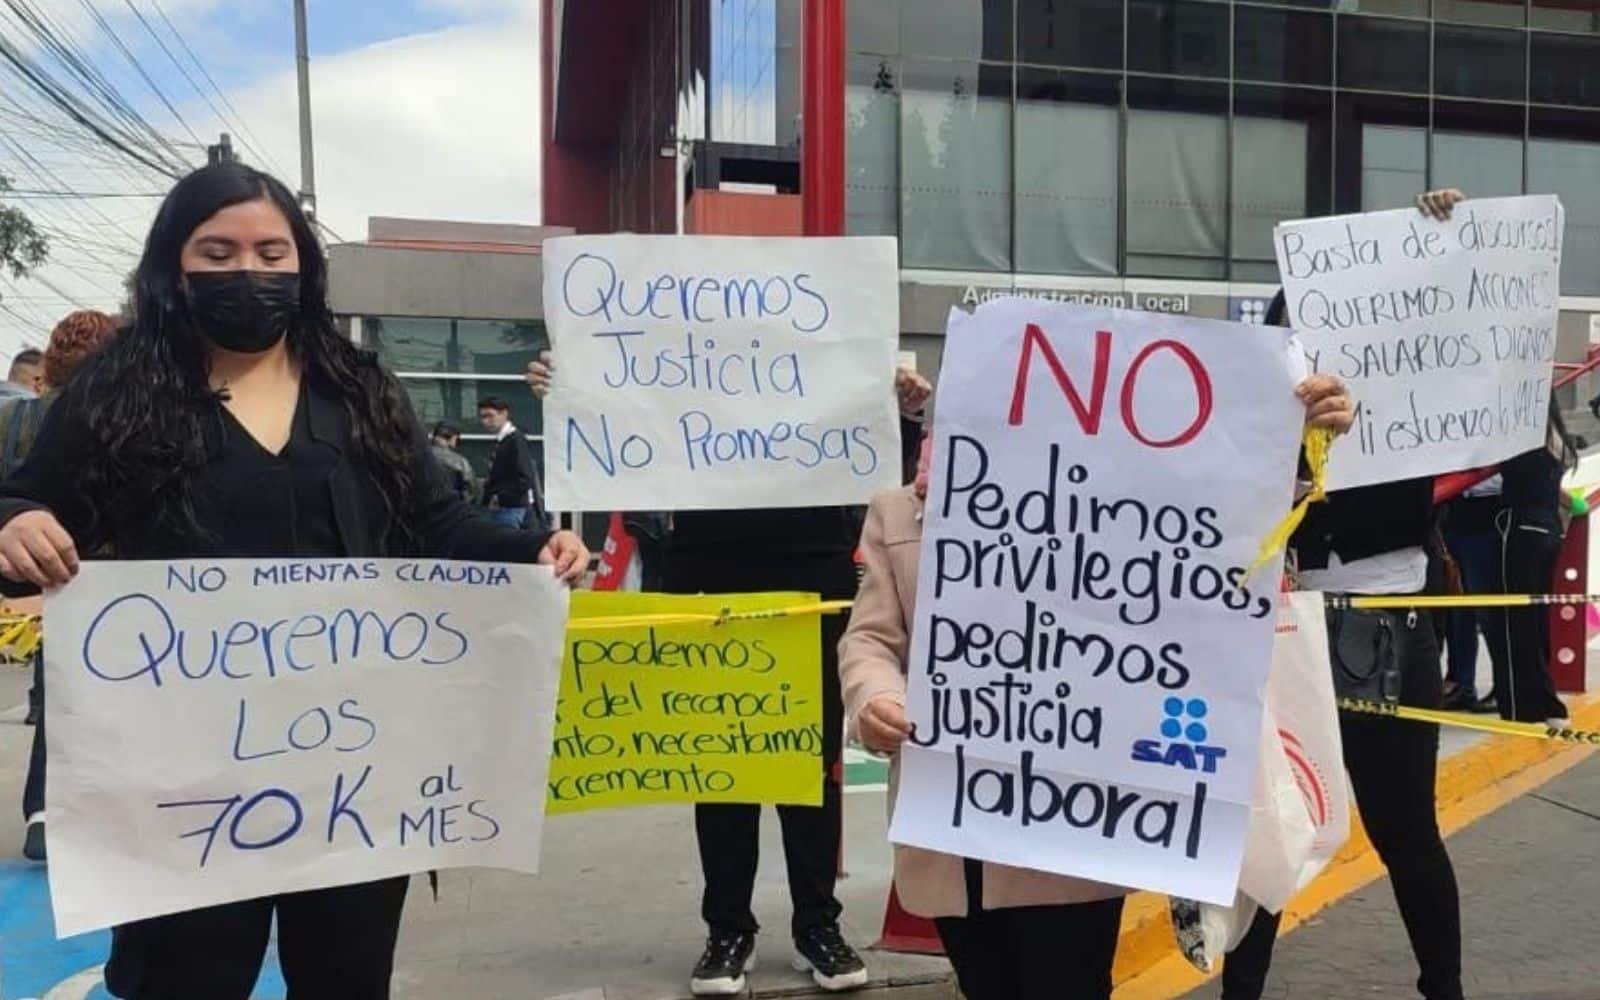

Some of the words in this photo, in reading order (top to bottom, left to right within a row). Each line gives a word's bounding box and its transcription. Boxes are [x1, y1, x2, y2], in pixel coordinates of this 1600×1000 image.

[1281, 225, 1382, 279] Basta
[1403, 221, 1446, 259] de
[563, 253, 829, 332] Queremos
[1132, 291, 1189, 312] Local
[591, 331, 803, 397] Justicia
[1008, 322, 1214, 449] NO
[1338, 332, 1481, 379] SALARIOS
[566, 414, 653, 477] No
[679, 410, 877, 476] Promesas
[1385, 391, 1493, 452] esfuerzo
[941, 435, 1224, 549] Pedimos
[167, 564, 226, 593] NO
[253, 564, 379, 587] MIENTAS
[396, 563, 511, 585] CLAUDIA
[934, 533, 1272, 624] privilegios,
[83, 593, 468, 687] Queremos
[572, 626, 776, 693] podemos
[927, 601, 1191, 690] pedimos
[232, 698, 377, 761] LOS
[583, 680, 643, 720] del
[909, 672, 1103, 750] justicia
[632, 721, 823, 757] necesitamos
[1131, 739, 1226, 773] SAT
[419, 764, 463, 798] al
[952, 745, 1206, 859] laboral
[399, 800, 499, 847] MES
